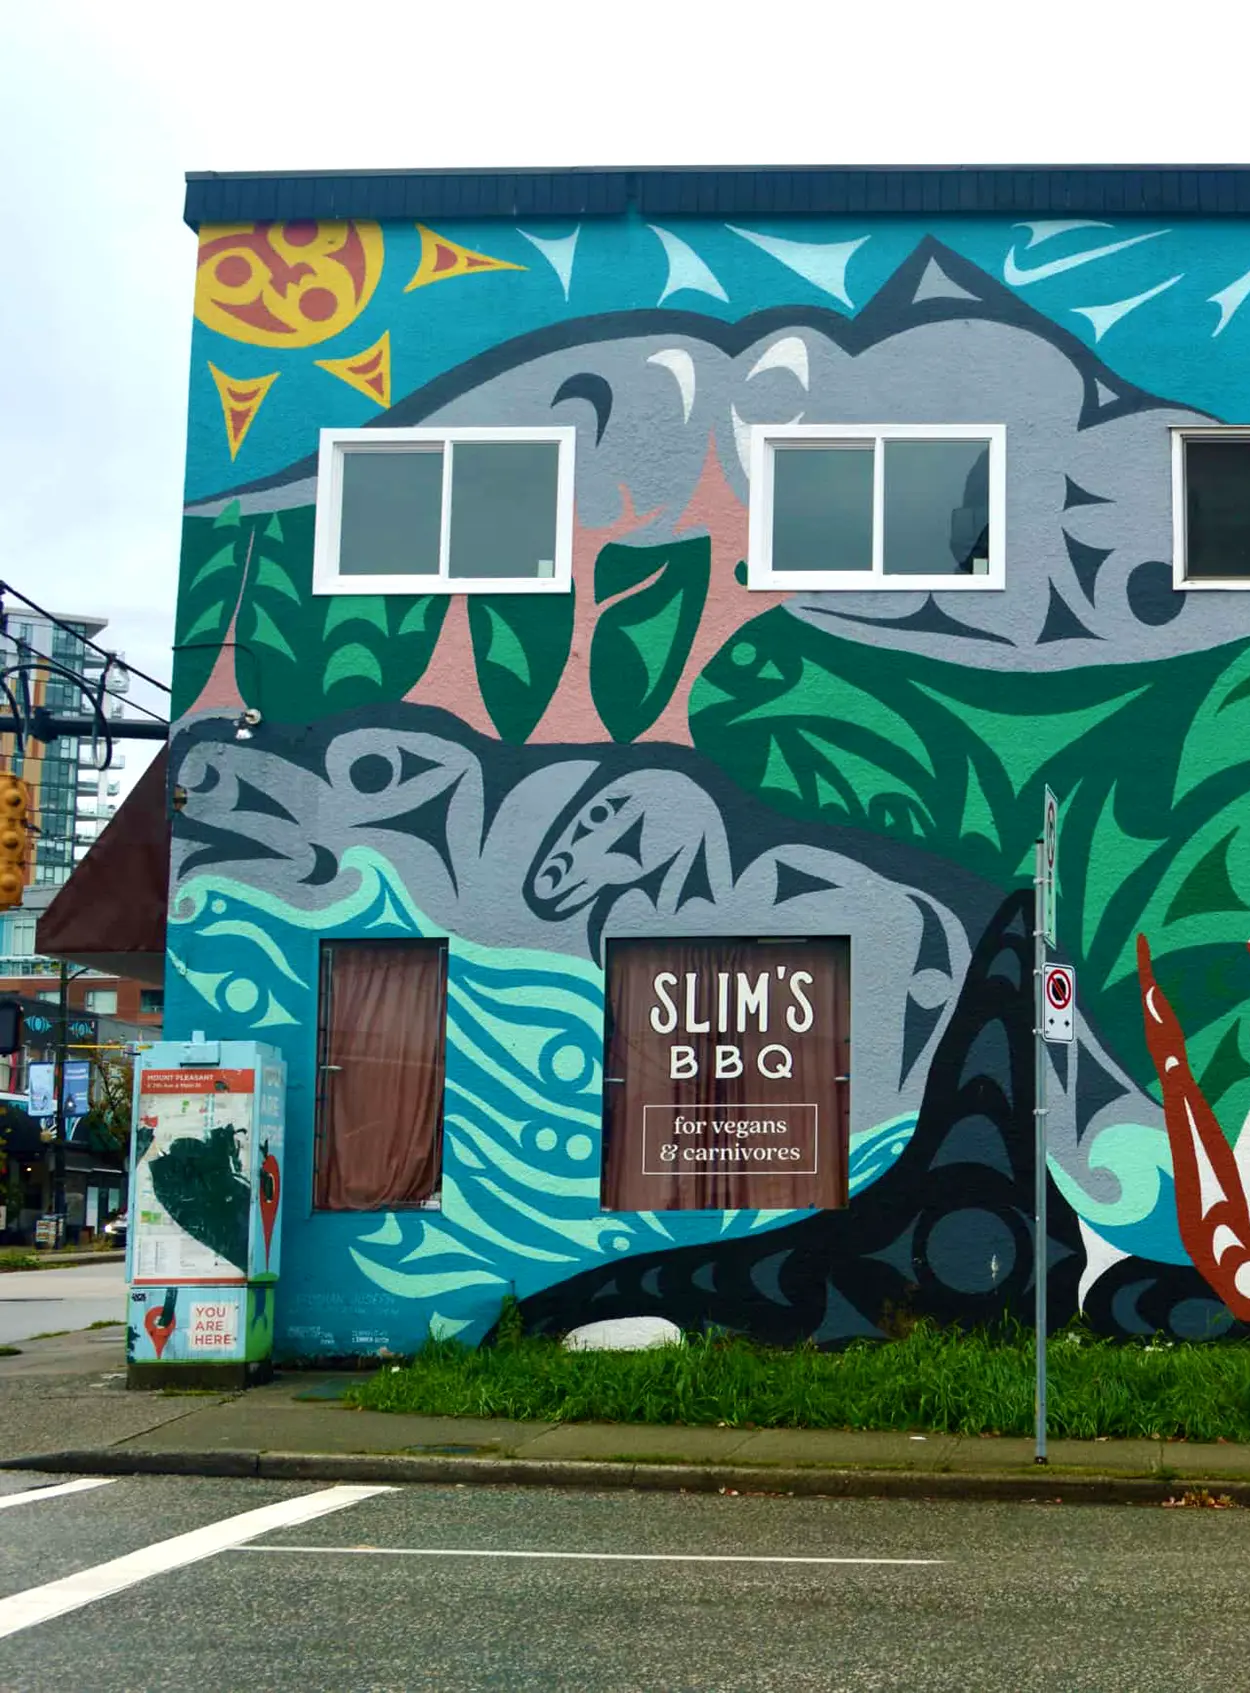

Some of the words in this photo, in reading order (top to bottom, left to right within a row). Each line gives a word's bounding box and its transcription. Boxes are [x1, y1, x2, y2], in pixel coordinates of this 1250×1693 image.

[650, 966, 814, 1034] SLIM'S
[669, 1043, 793, 1080] BBQ
[147, 1074, 173, 1082] MOUNT
[175, 1073, 214, 1081] PLEASANT
[673, 1115, 707, 1135] for
[712, 1117, 788, 1138] vegans
[659, 1143, 679, 1162] &
[682, 1141, 801, 1162] carnivores
[195, 1306, 227, 1318] YOU
[195, 1320, 225, 1331] ARE
[195, 1334, 232, 1346] HERE
